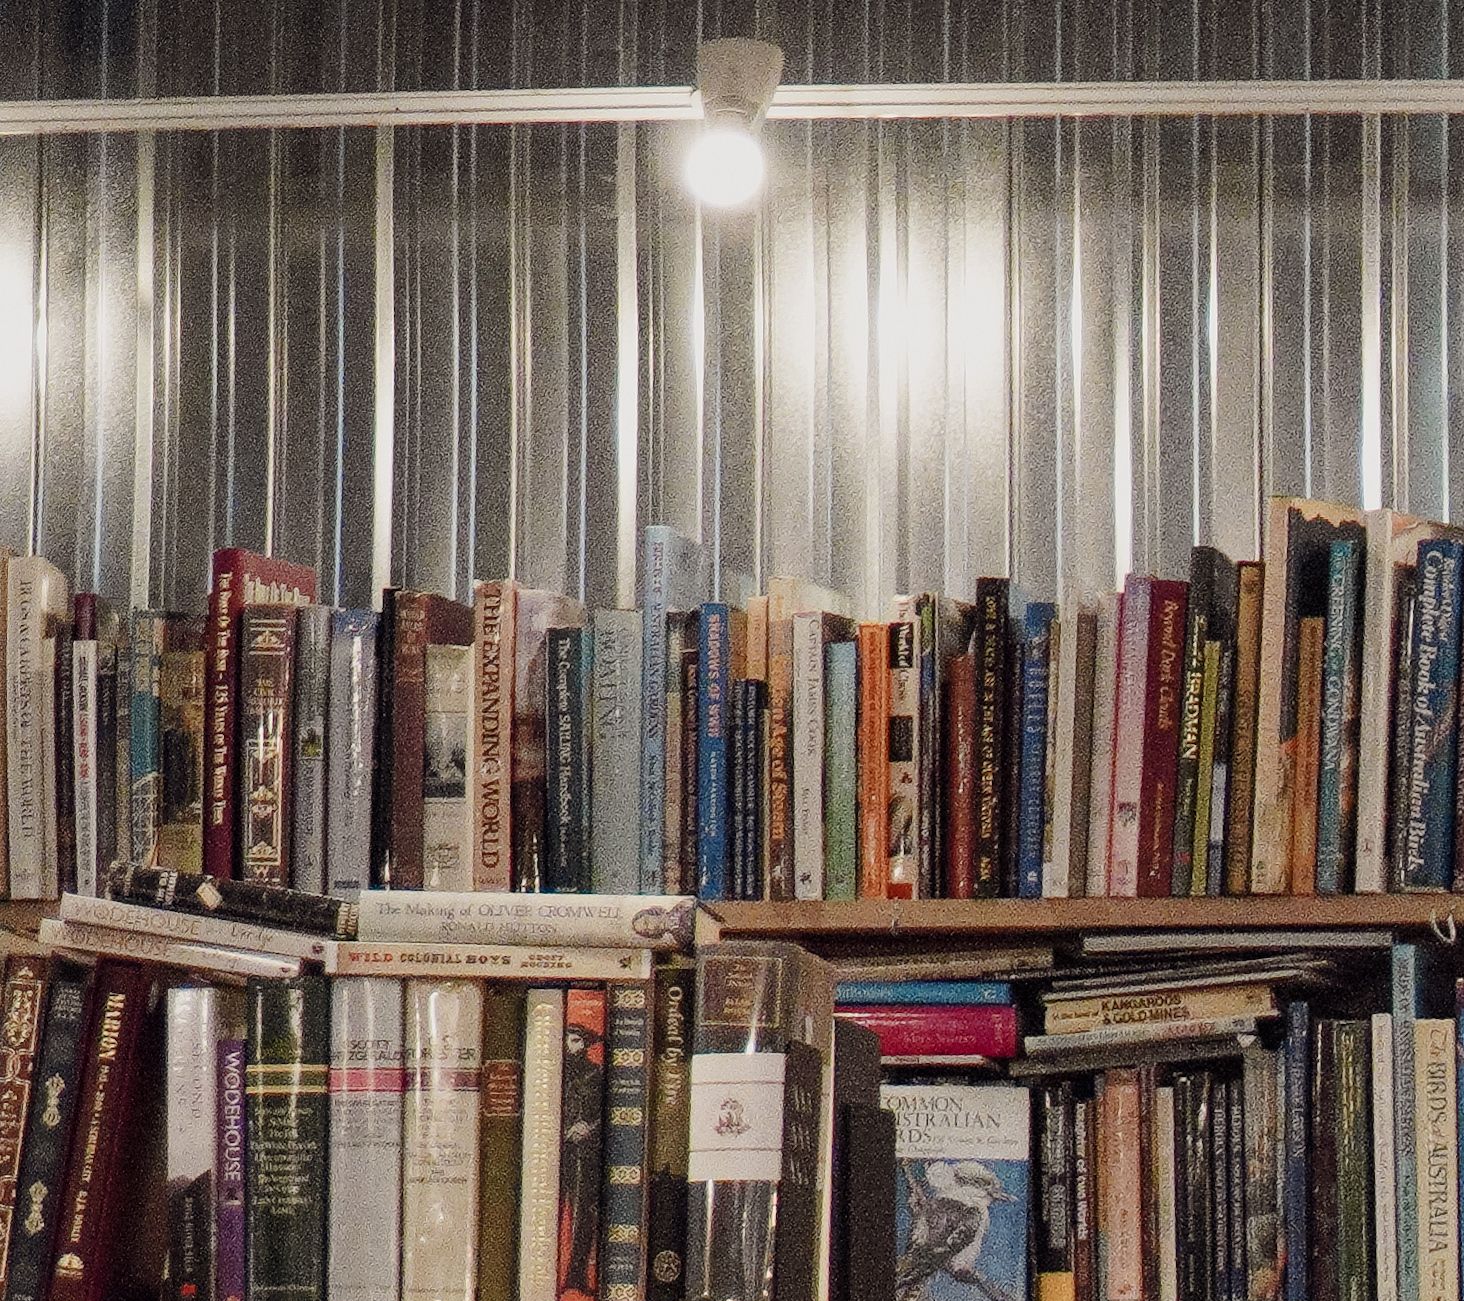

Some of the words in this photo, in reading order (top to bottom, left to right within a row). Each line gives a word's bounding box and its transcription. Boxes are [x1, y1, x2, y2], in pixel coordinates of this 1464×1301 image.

[482, 591, 502, 634] THE
[1419, 551, 1444, 639] Complete
[1413, 694, 1434, 715] of
[1417, 643, 1437, 690] Book
[480, 641, 501, 773] EXPANDING
[1411, 718, 1431, 815] Australian
[482, 781, 500, 868] WORLD
[1407, 820, 1426, 872] Birds
[98, 992, 125, 1060] MARION
[224, 1052, 241, 1181] WODEHOUSE
